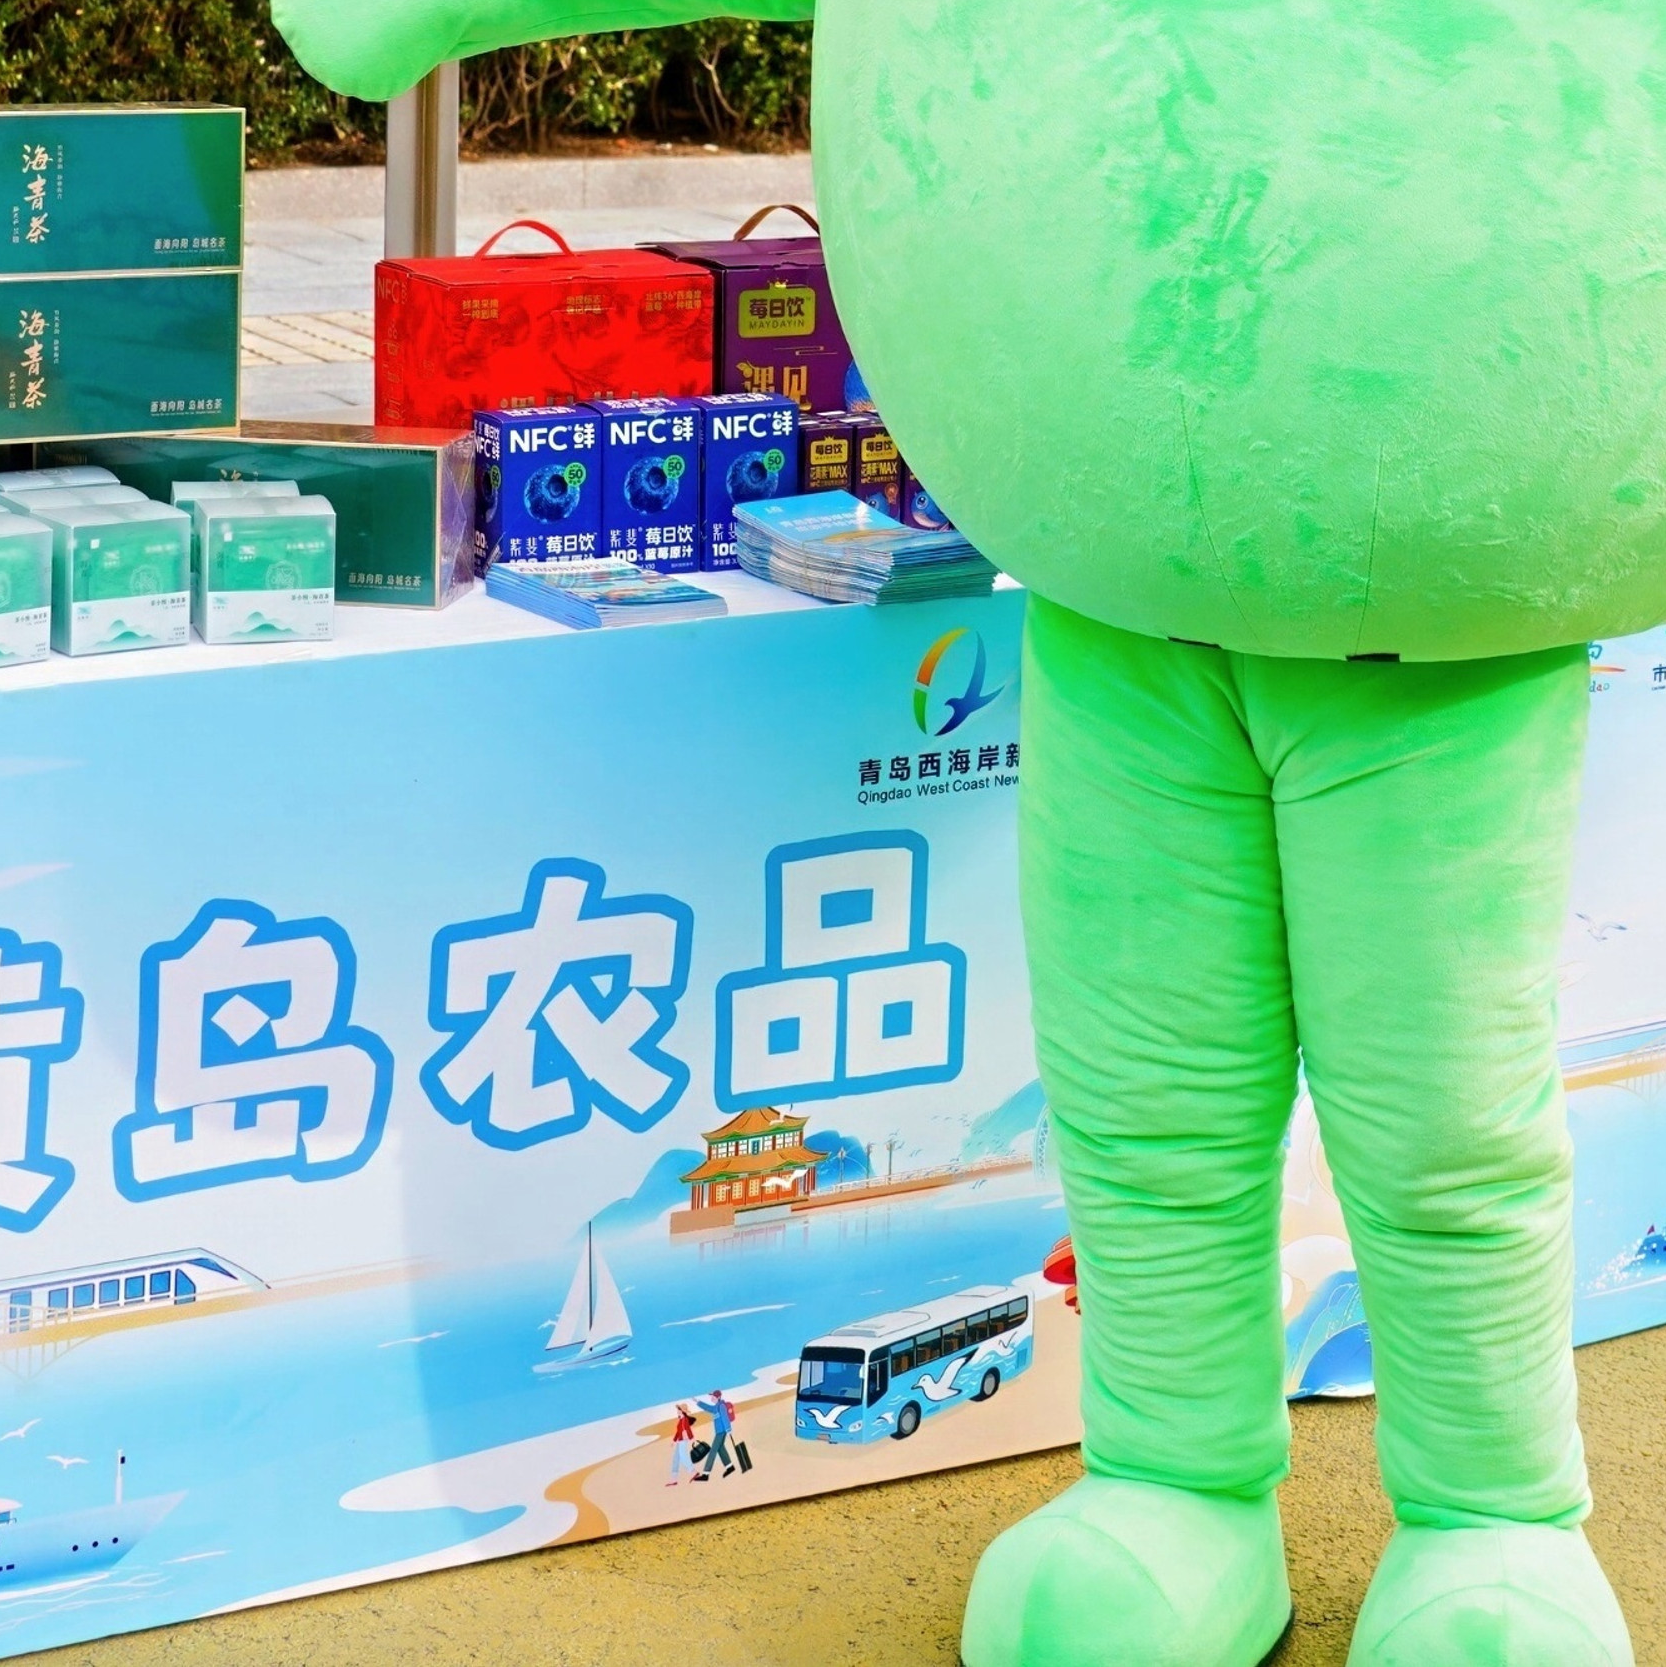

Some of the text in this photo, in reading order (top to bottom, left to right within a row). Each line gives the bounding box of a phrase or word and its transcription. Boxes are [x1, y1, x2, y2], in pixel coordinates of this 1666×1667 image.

[21, 143, 54, 244] 海青茶
[749, 297, 805, 319] 莓日饮
[749, 319, 805, 330] MAYDAYIN
[18, 308, 50, 409] 海青茶
[667, 461, 682, 472] 50
[767, 455, 782, 466] 50
[568, 468, 583, 480] 50
[857, 774, 1020, 806] Qingdao West Coast New
